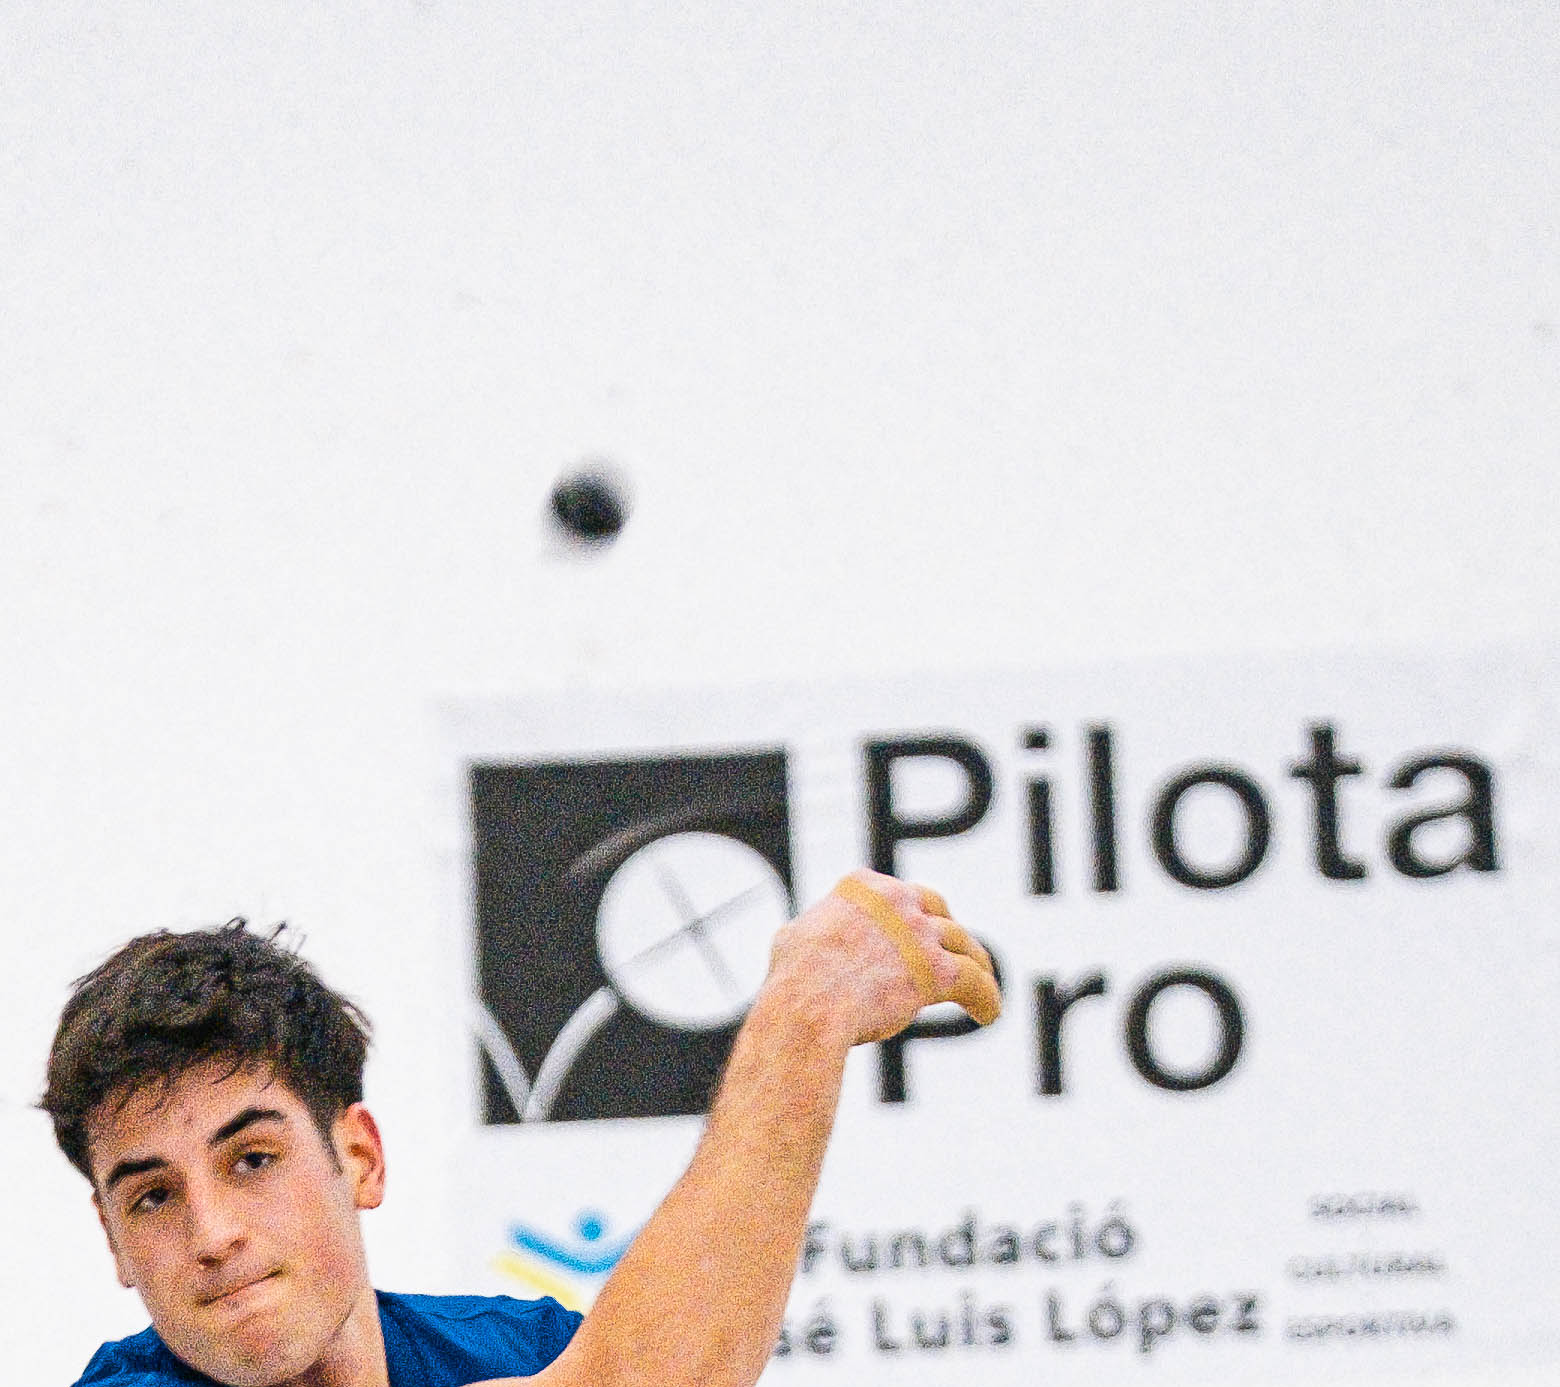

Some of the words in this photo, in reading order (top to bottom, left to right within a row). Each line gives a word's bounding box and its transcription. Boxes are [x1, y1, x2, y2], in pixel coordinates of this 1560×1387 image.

[863, 722, 1503, 895] Pilota
[802, 1200, 1136, 1273] Fundació
[870, 1287, 1013, 1352] Luis
[1043, 1281, 1262, 1354] López
